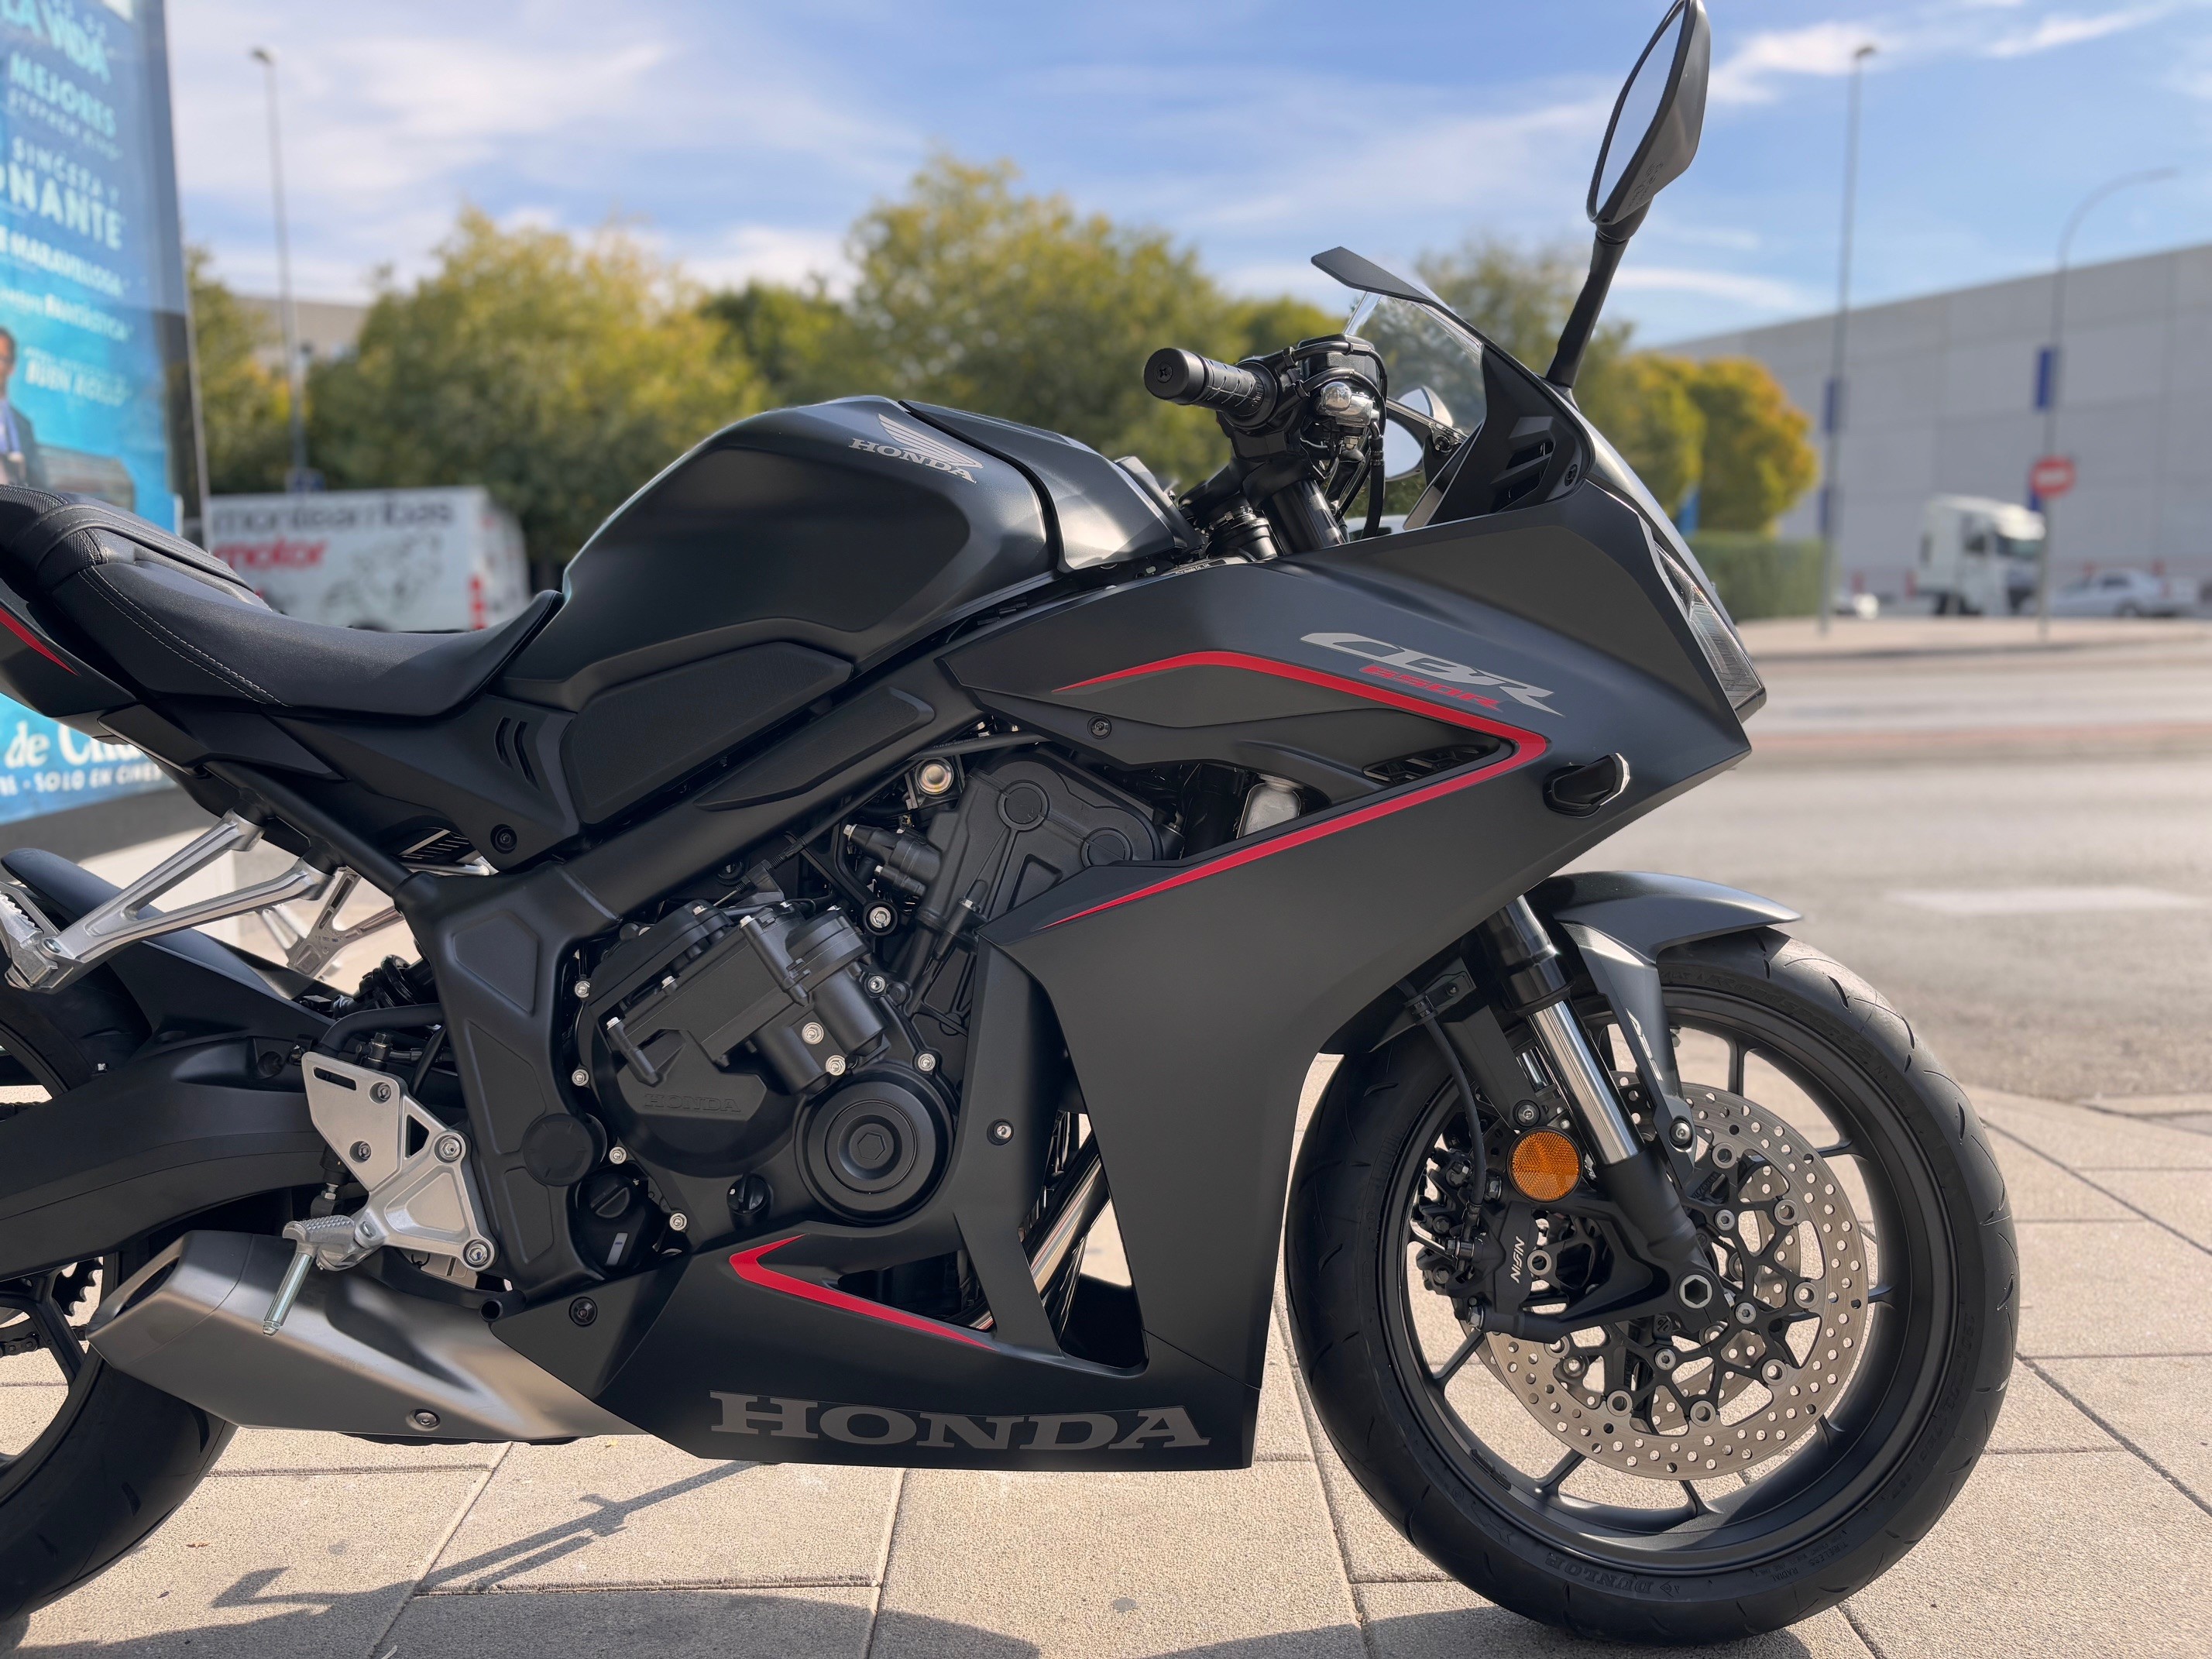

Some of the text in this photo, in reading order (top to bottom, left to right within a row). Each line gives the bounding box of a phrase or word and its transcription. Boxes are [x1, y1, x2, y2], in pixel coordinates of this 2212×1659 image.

[10, 50, 116, 138] MEJORES
[849, 438, 977, 484] HONDA
[214, 535, 328, 569] motor
[1300, 633, 1565, 717] CBR
[1359, 665, 1503, 713] 650R
[5, 720, 50, 769] de
[34, 770, 85, 792] SOLO
[1625, 1008, 1664, 1081] ABS
[644, 1093, 741, 1113] HONDA
[709, 1390, 1211, 1450] HONDA
[1543, 1551, 1654, 1594] DUNLOP
